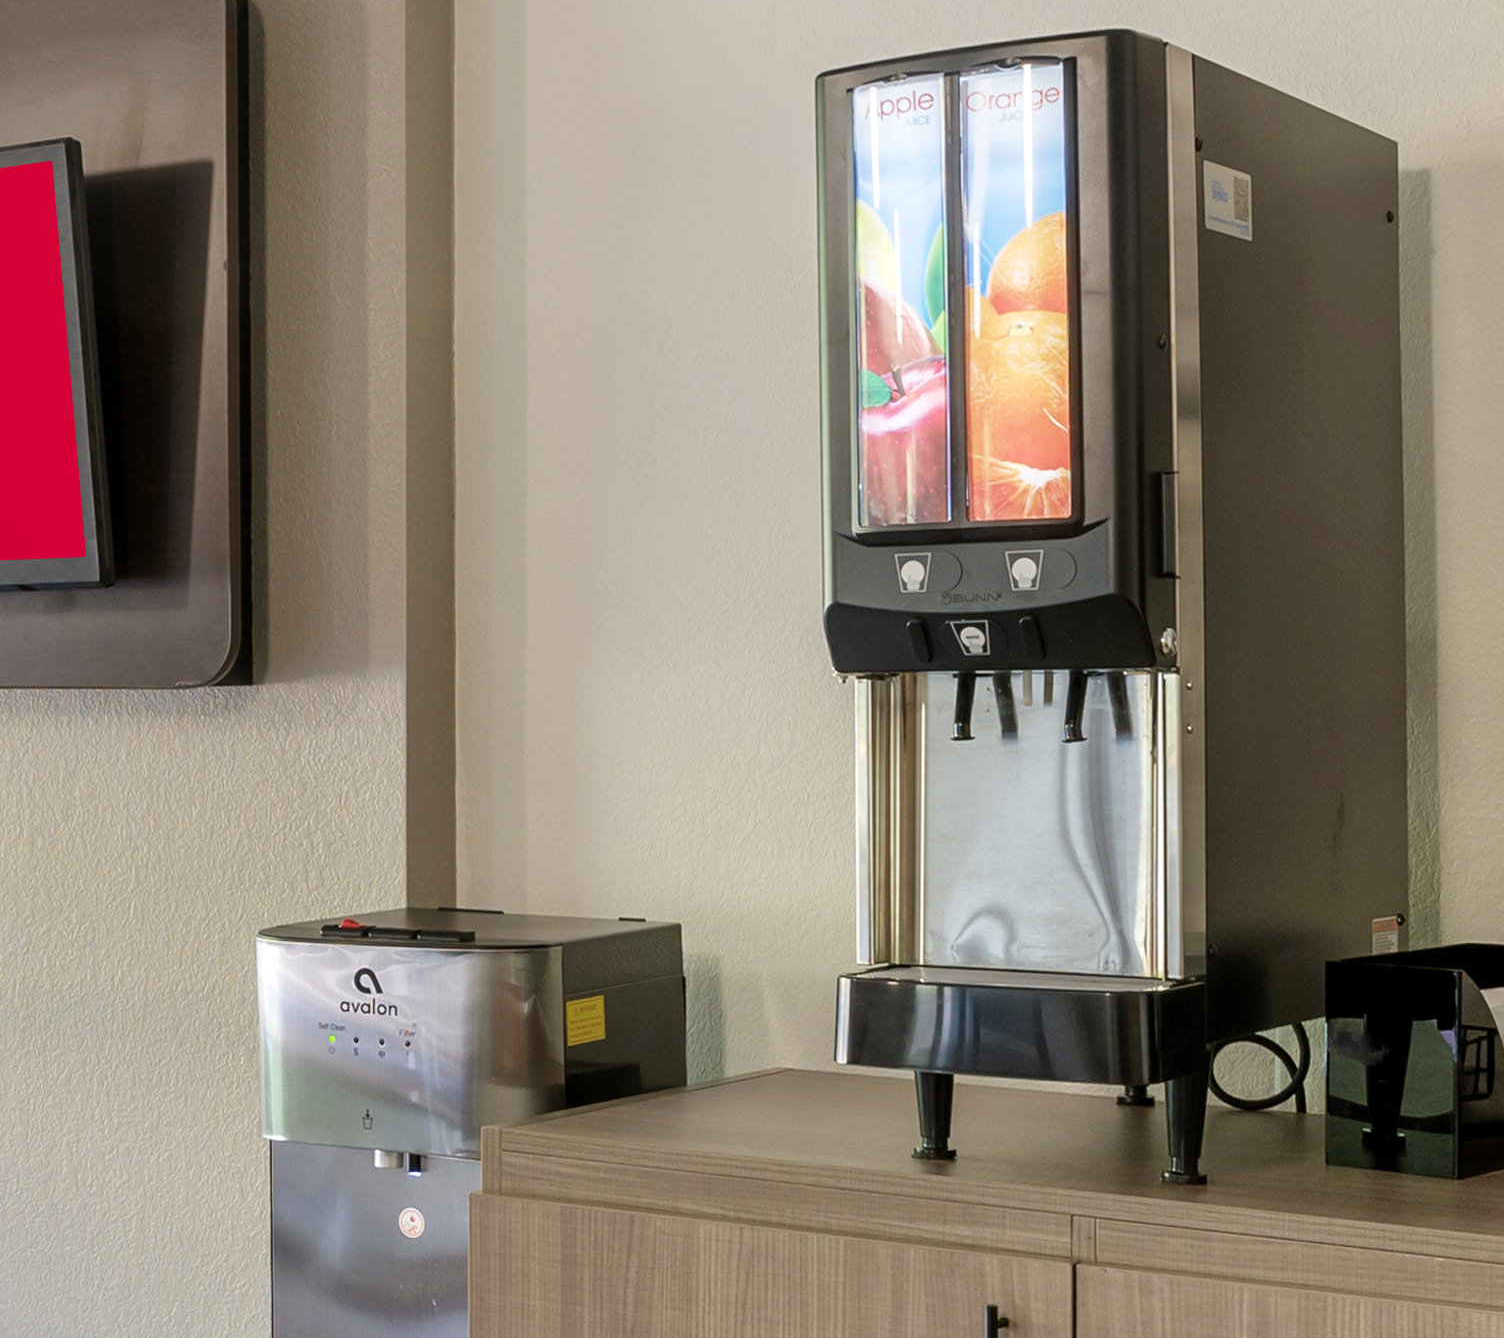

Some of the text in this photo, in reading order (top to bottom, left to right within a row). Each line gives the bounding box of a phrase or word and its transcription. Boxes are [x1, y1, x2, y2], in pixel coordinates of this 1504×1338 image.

[904, 115, 931, 127] JUICE
[999, 112, 1023, 123] JUIC
[953, 593, 998, 603] BUNN
[340, 998, 398, 1016] avalon
